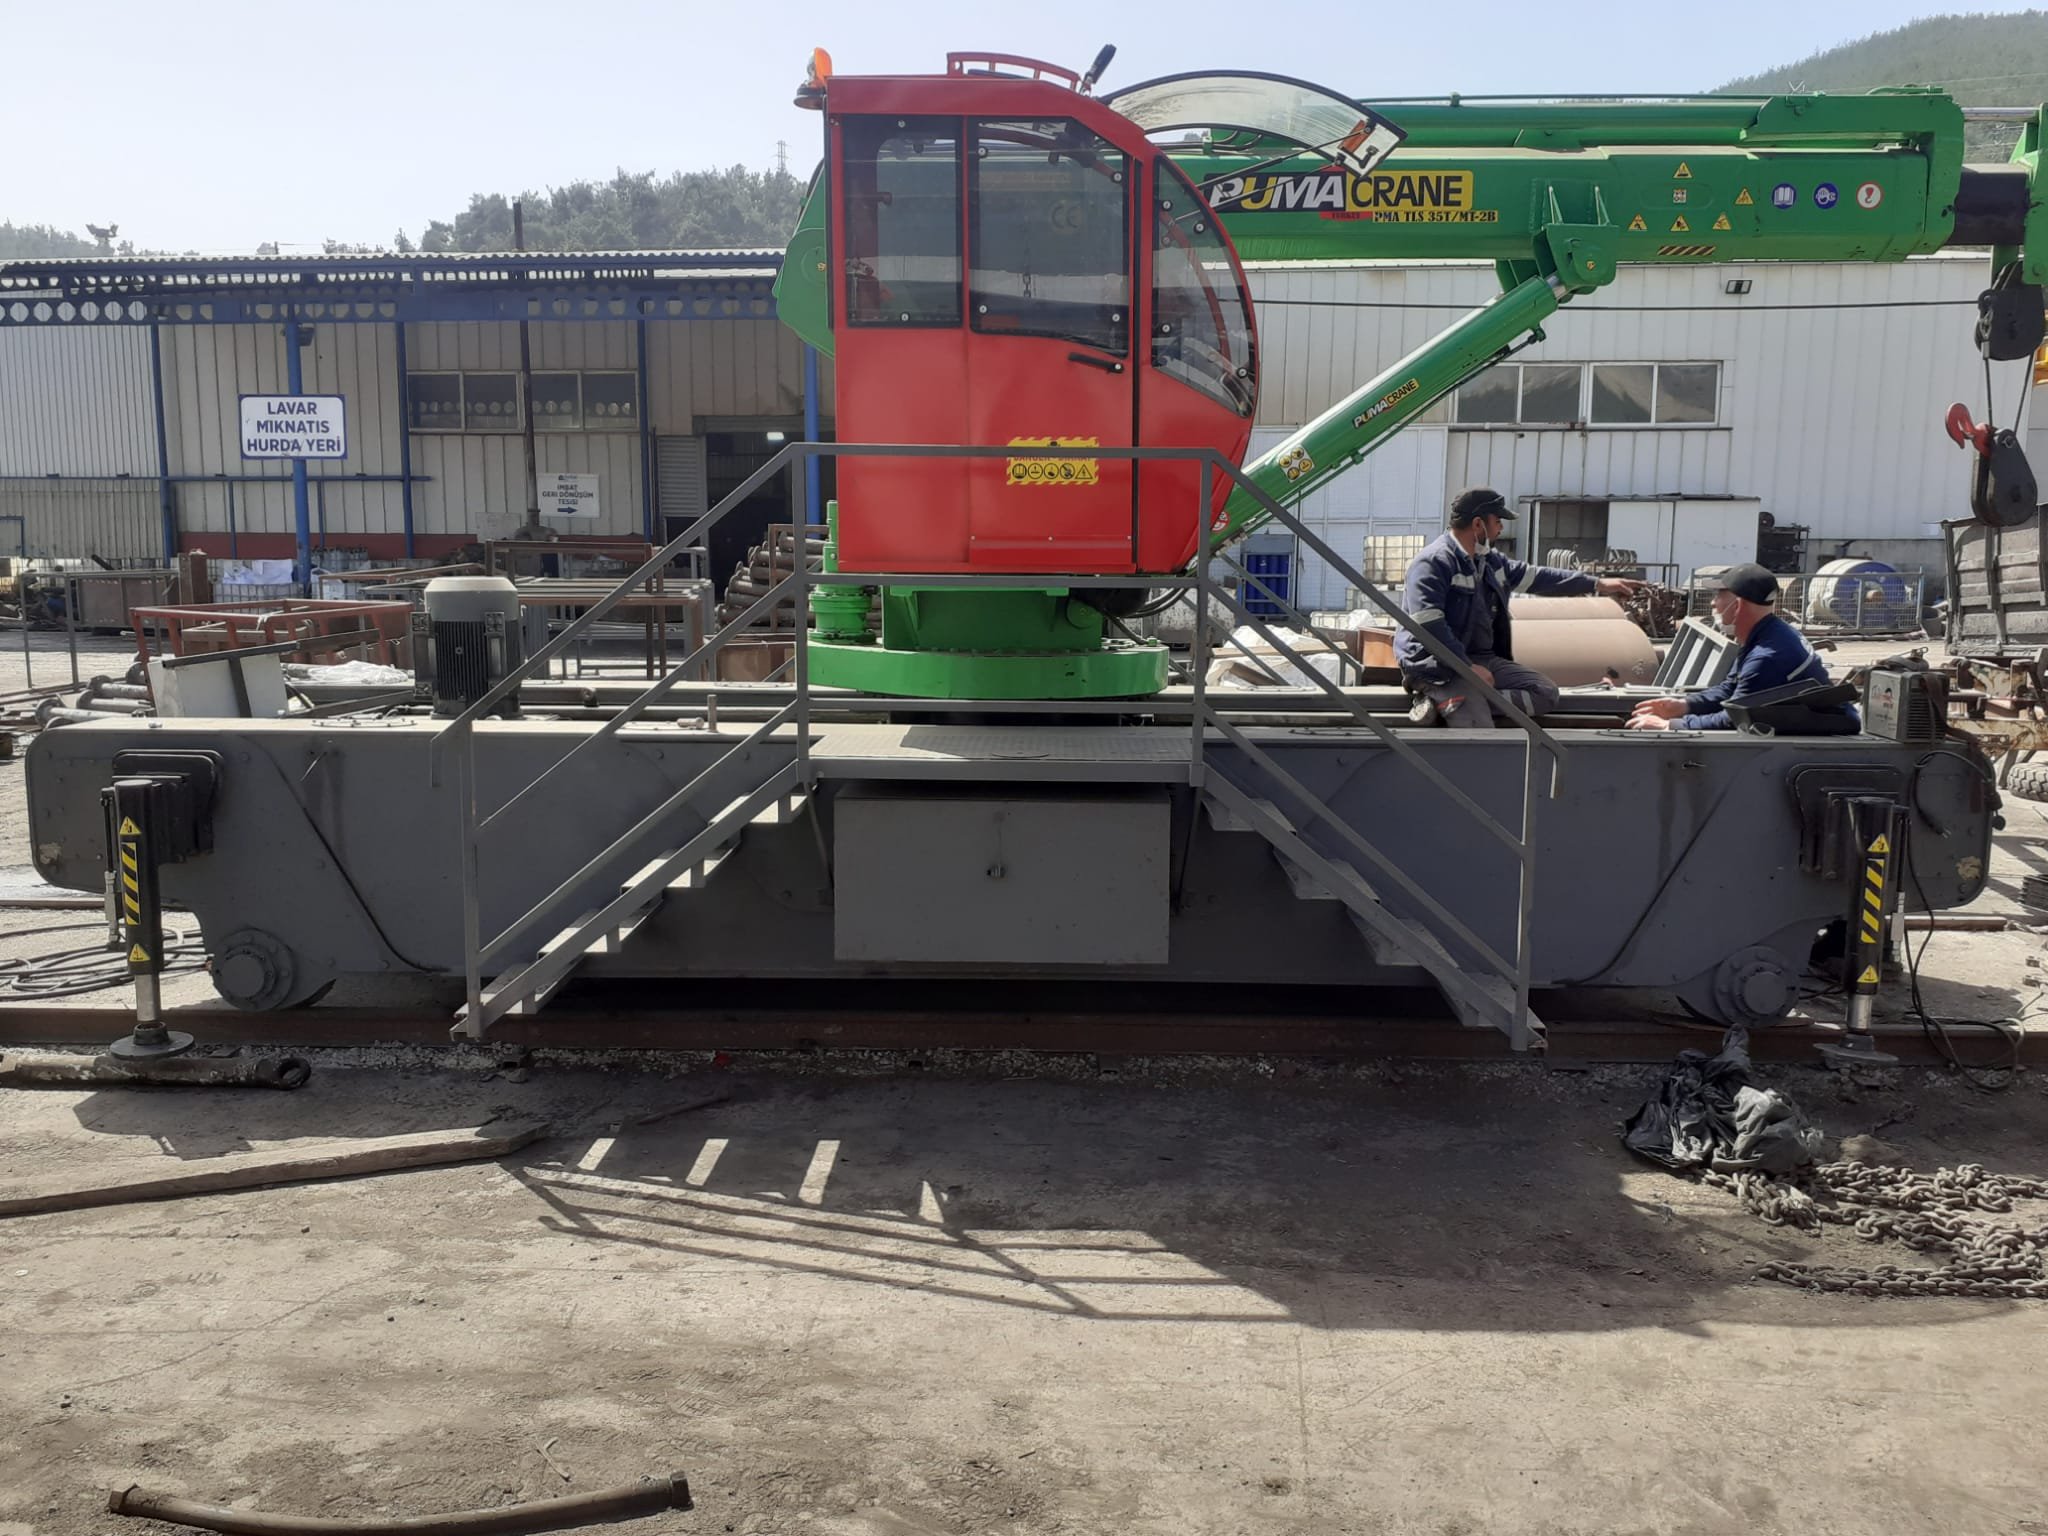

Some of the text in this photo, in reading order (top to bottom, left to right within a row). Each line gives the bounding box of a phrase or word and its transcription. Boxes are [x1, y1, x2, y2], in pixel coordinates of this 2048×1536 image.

[1374, 210, 1400, 222] PMA
[1404, 210, 1424, 222] TLS
[267, 401, 317, 415] LAVAR
[256, 420, 330, 433] MIKNATIS
[247, 436, 341, 452] HURDA YERİ
